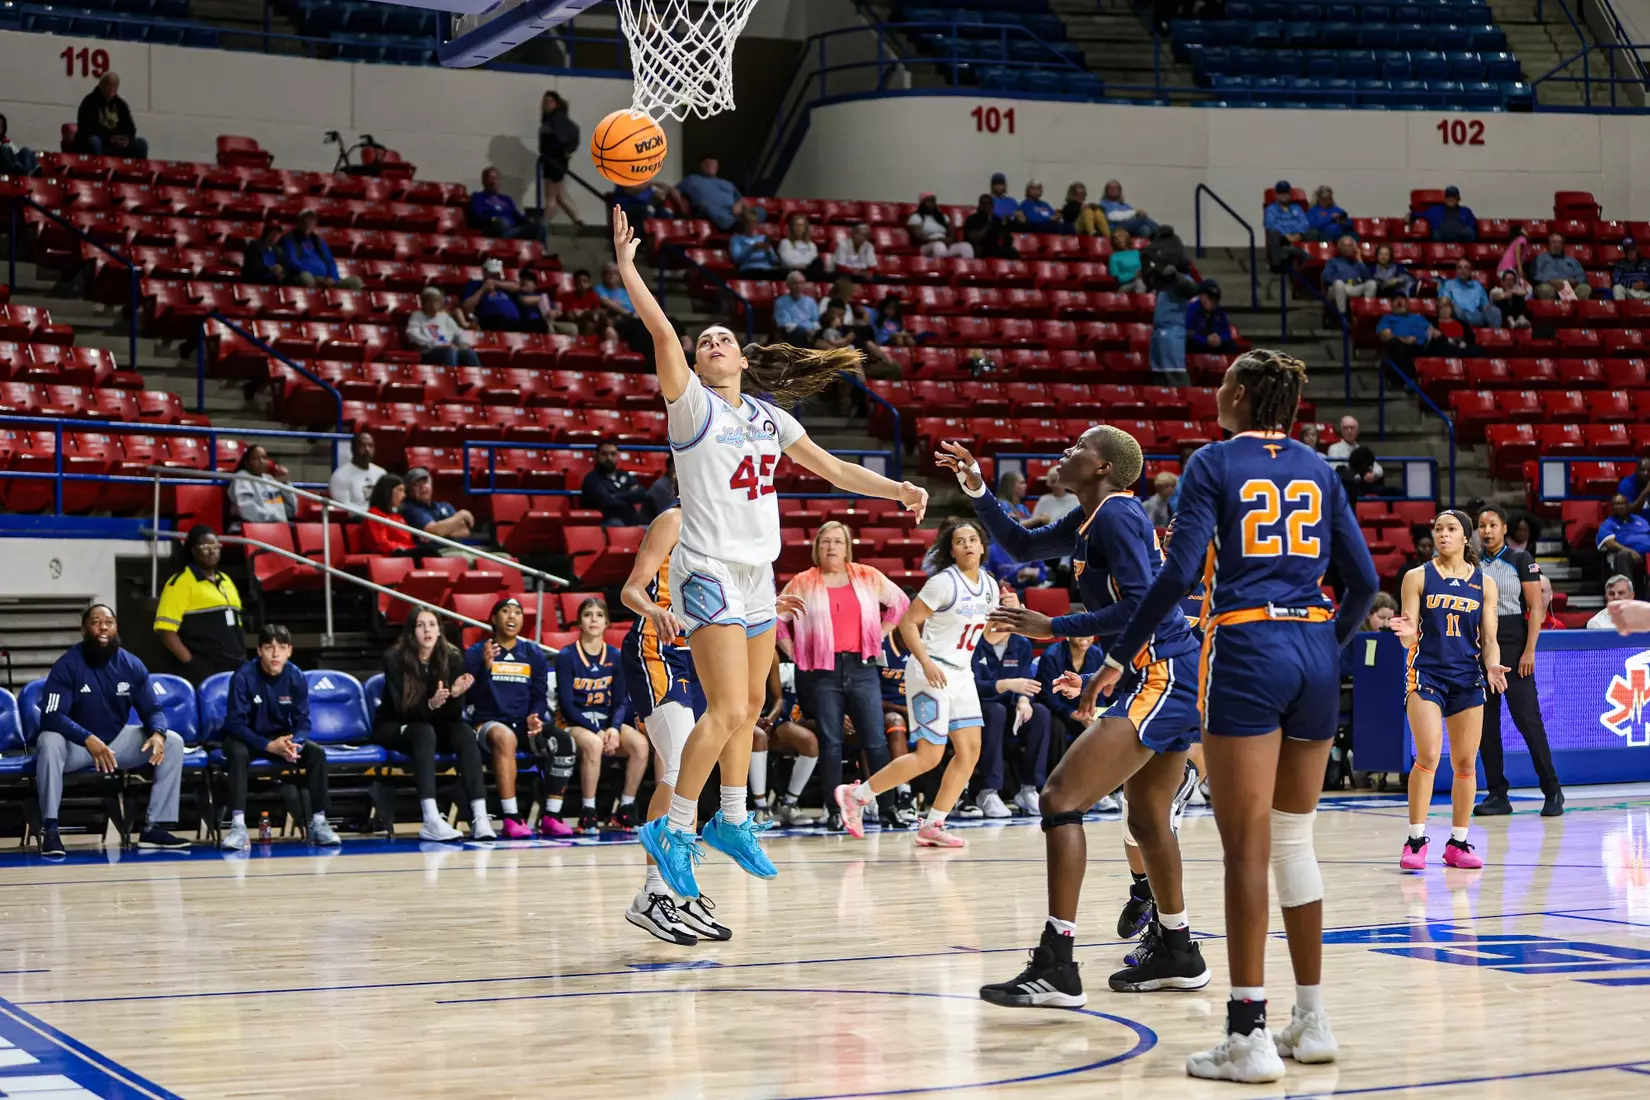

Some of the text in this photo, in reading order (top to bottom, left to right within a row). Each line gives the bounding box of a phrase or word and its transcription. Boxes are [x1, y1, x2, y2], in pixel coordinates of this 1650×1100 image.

[60, 46, 110, 78] 119
[971, 105, 1015, 134] 101
[1436, 119, 1485, 145] 102
[634, 135, 664, 154] NCAA
[730, 455, 776, 501] 45
[1239, 479, 1322, 558] 22
[1426, 594, 1480, 613] UTEP
[1446, 613, 1461, 637] 11
